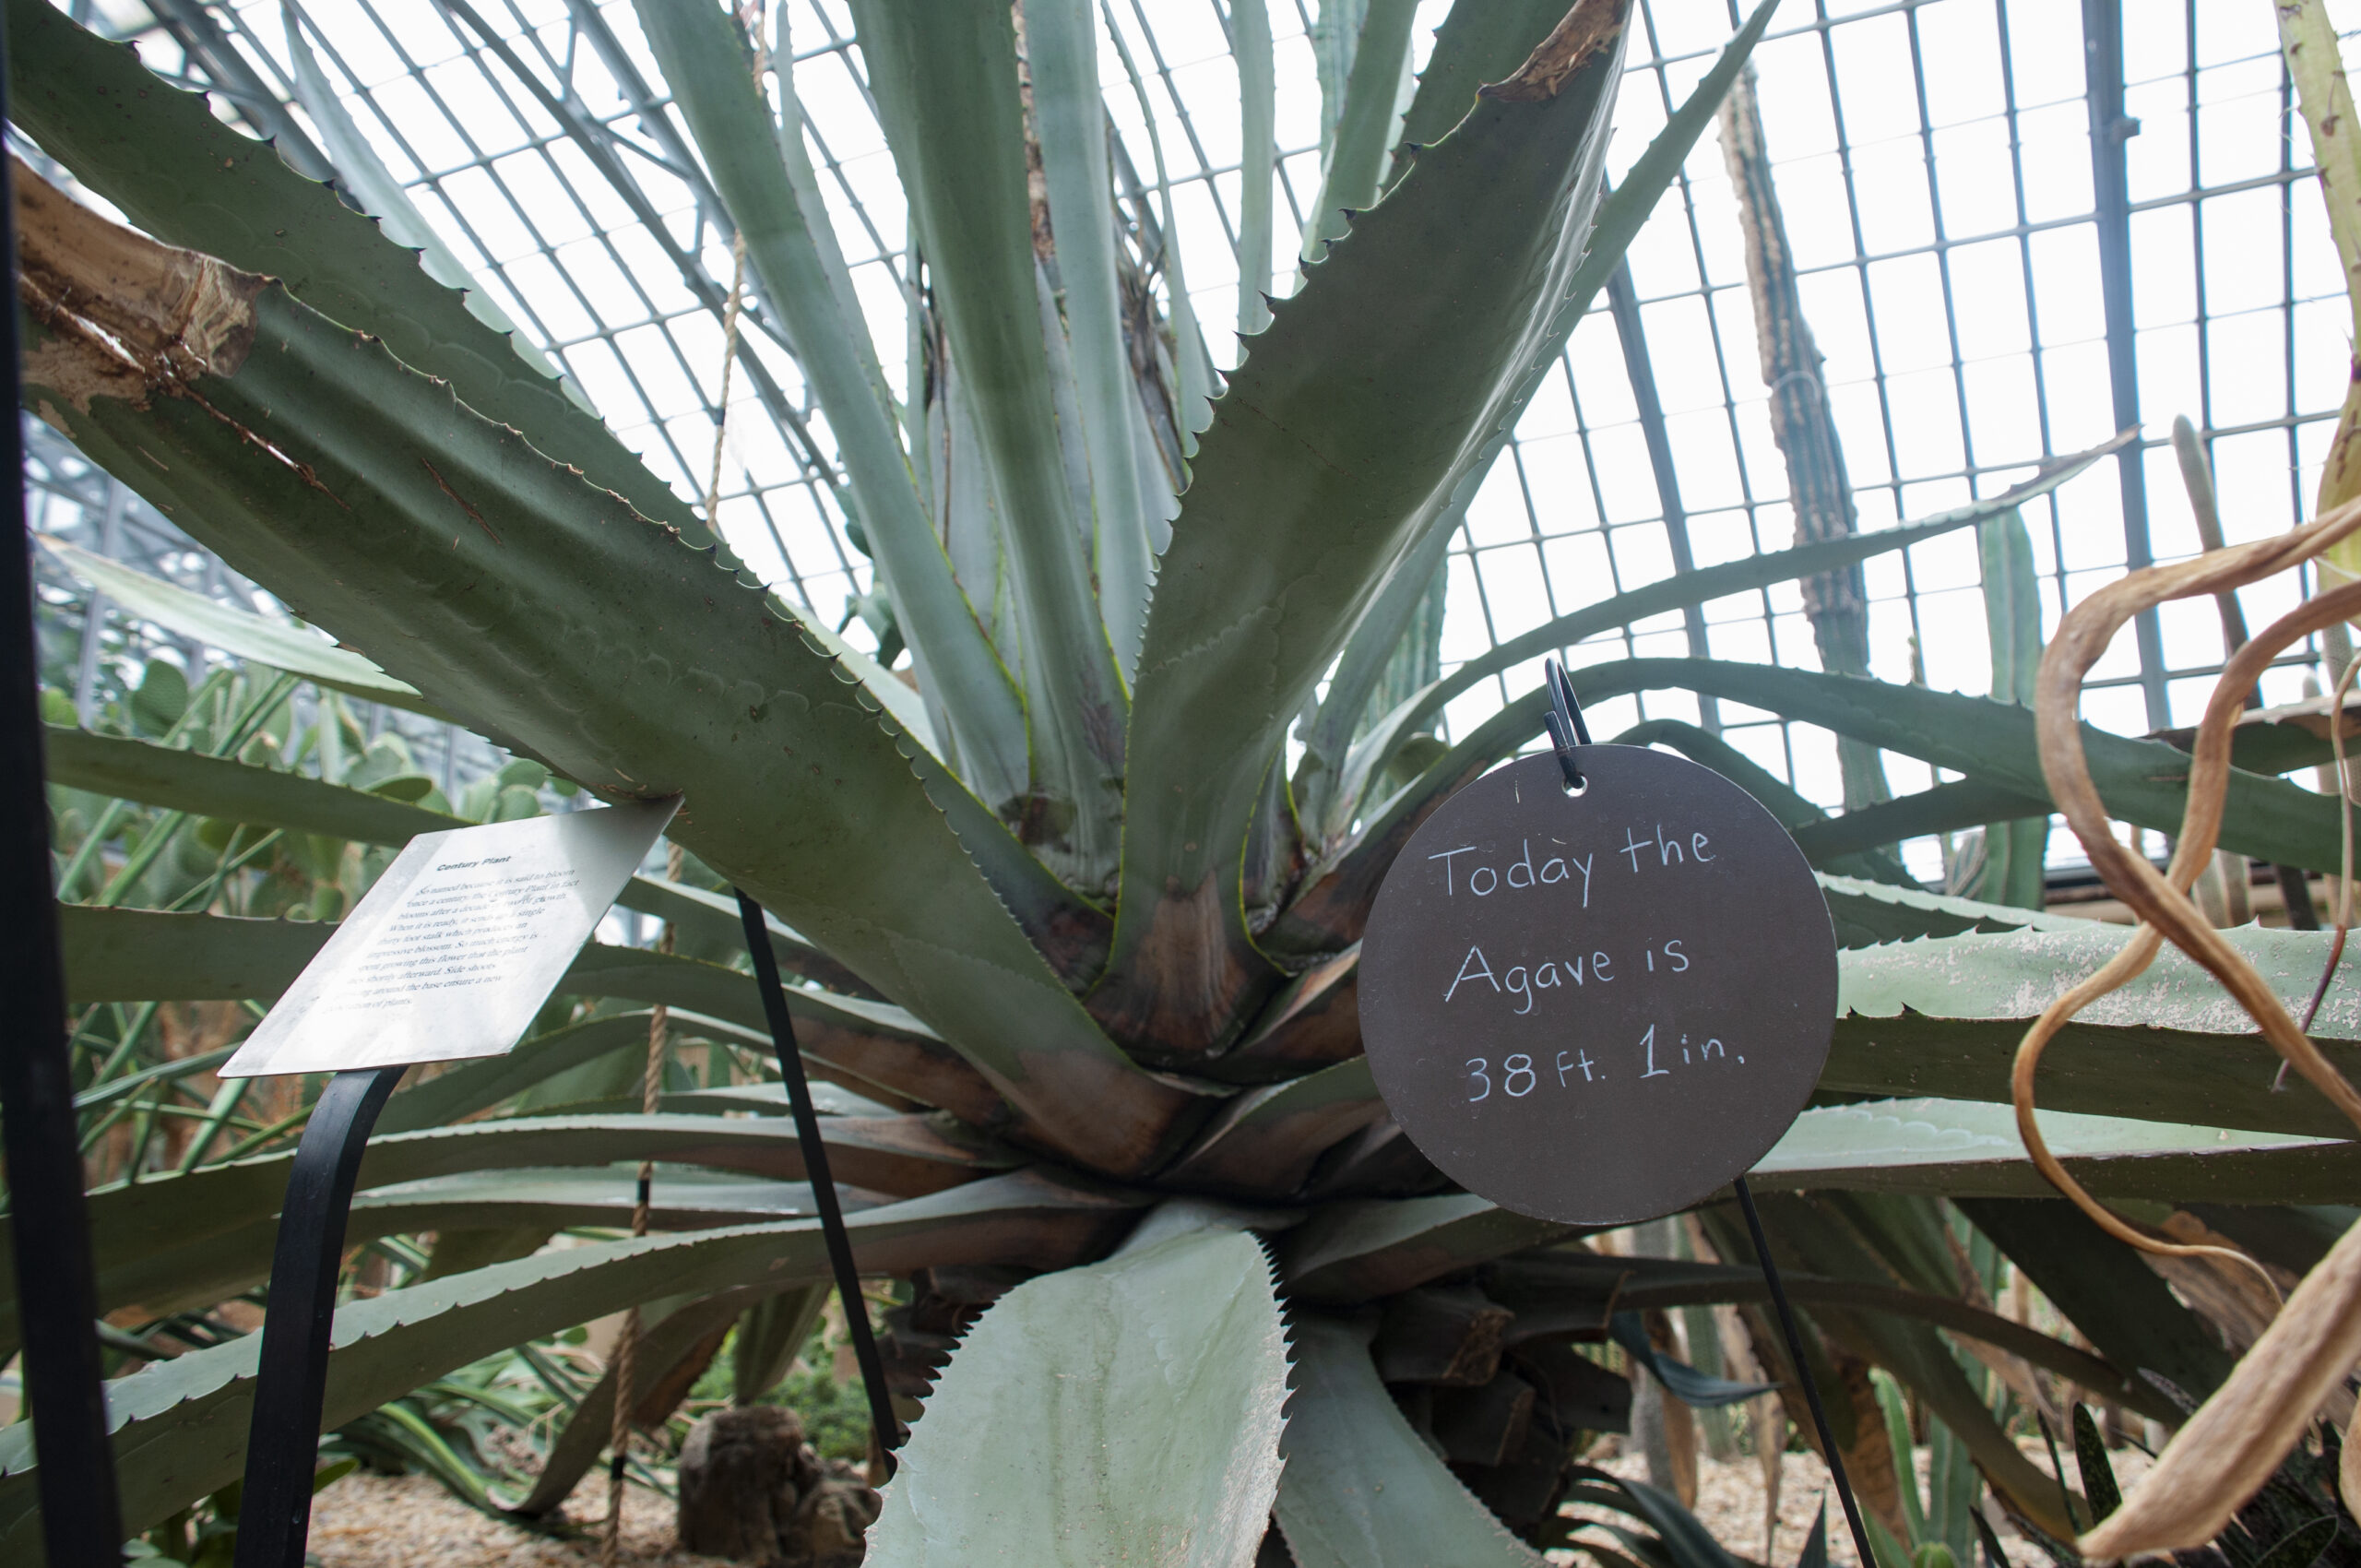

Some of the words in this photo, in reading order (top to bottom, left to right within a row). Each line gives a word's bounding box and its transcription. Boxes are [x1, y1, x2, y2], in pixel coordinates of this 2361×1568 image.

[435, 860, 480, 872] Century
[481, 854, 512, 865] Plant
[1429, 839, 1594, 908] Today
[1619, 825, 1716, 873] the
[429, 883, 461, 894] named
[458, 880, 495, 891] because
[504, 874, 513, 885] is
[512, 872, 536, 884] said
[533, 873, 544, 881] to
[543, 867, 576, 879] bloom
[523, 882, 551, 893] Plant
[387, 923, 415, 932] When
[414, 921, 422, 930] it
[516, 906, 546, 918] single
[397, 910, 429, 921] blooms
[428, 907, 452, 917] after
[421, 930, 443, 941] stalk
[444, 927, 473, 938] which
[515, 921, 528, 930] an
[454, 939, 468, 949] So
[469, 935, 495, 947] much
[378, 958, 419, 971] growing
[418, 956, 436, 966] this
[435, 953, 468, 963] flower
[466, 950, 487, 959] that
[486, 947, 502, 957] the
[500, 944, 529, 957] plant
[443, 964, 467, 975] Side
[467, 962, 496, 972] shoots
[1444, 944, 1616, 1015] Agave
[1647, 937, 1691, 973] is
[405, 981, 421, 992] the
[420, 980, 444, 991] base
[442, 977, 475, 988] ensure
[482, 974, 502, 983] new
[1465, 1053, 1536, 1102] 38
[1638, 1024, 1670, 1079] 1
[1681, 1034, 1746, 1065] in.
